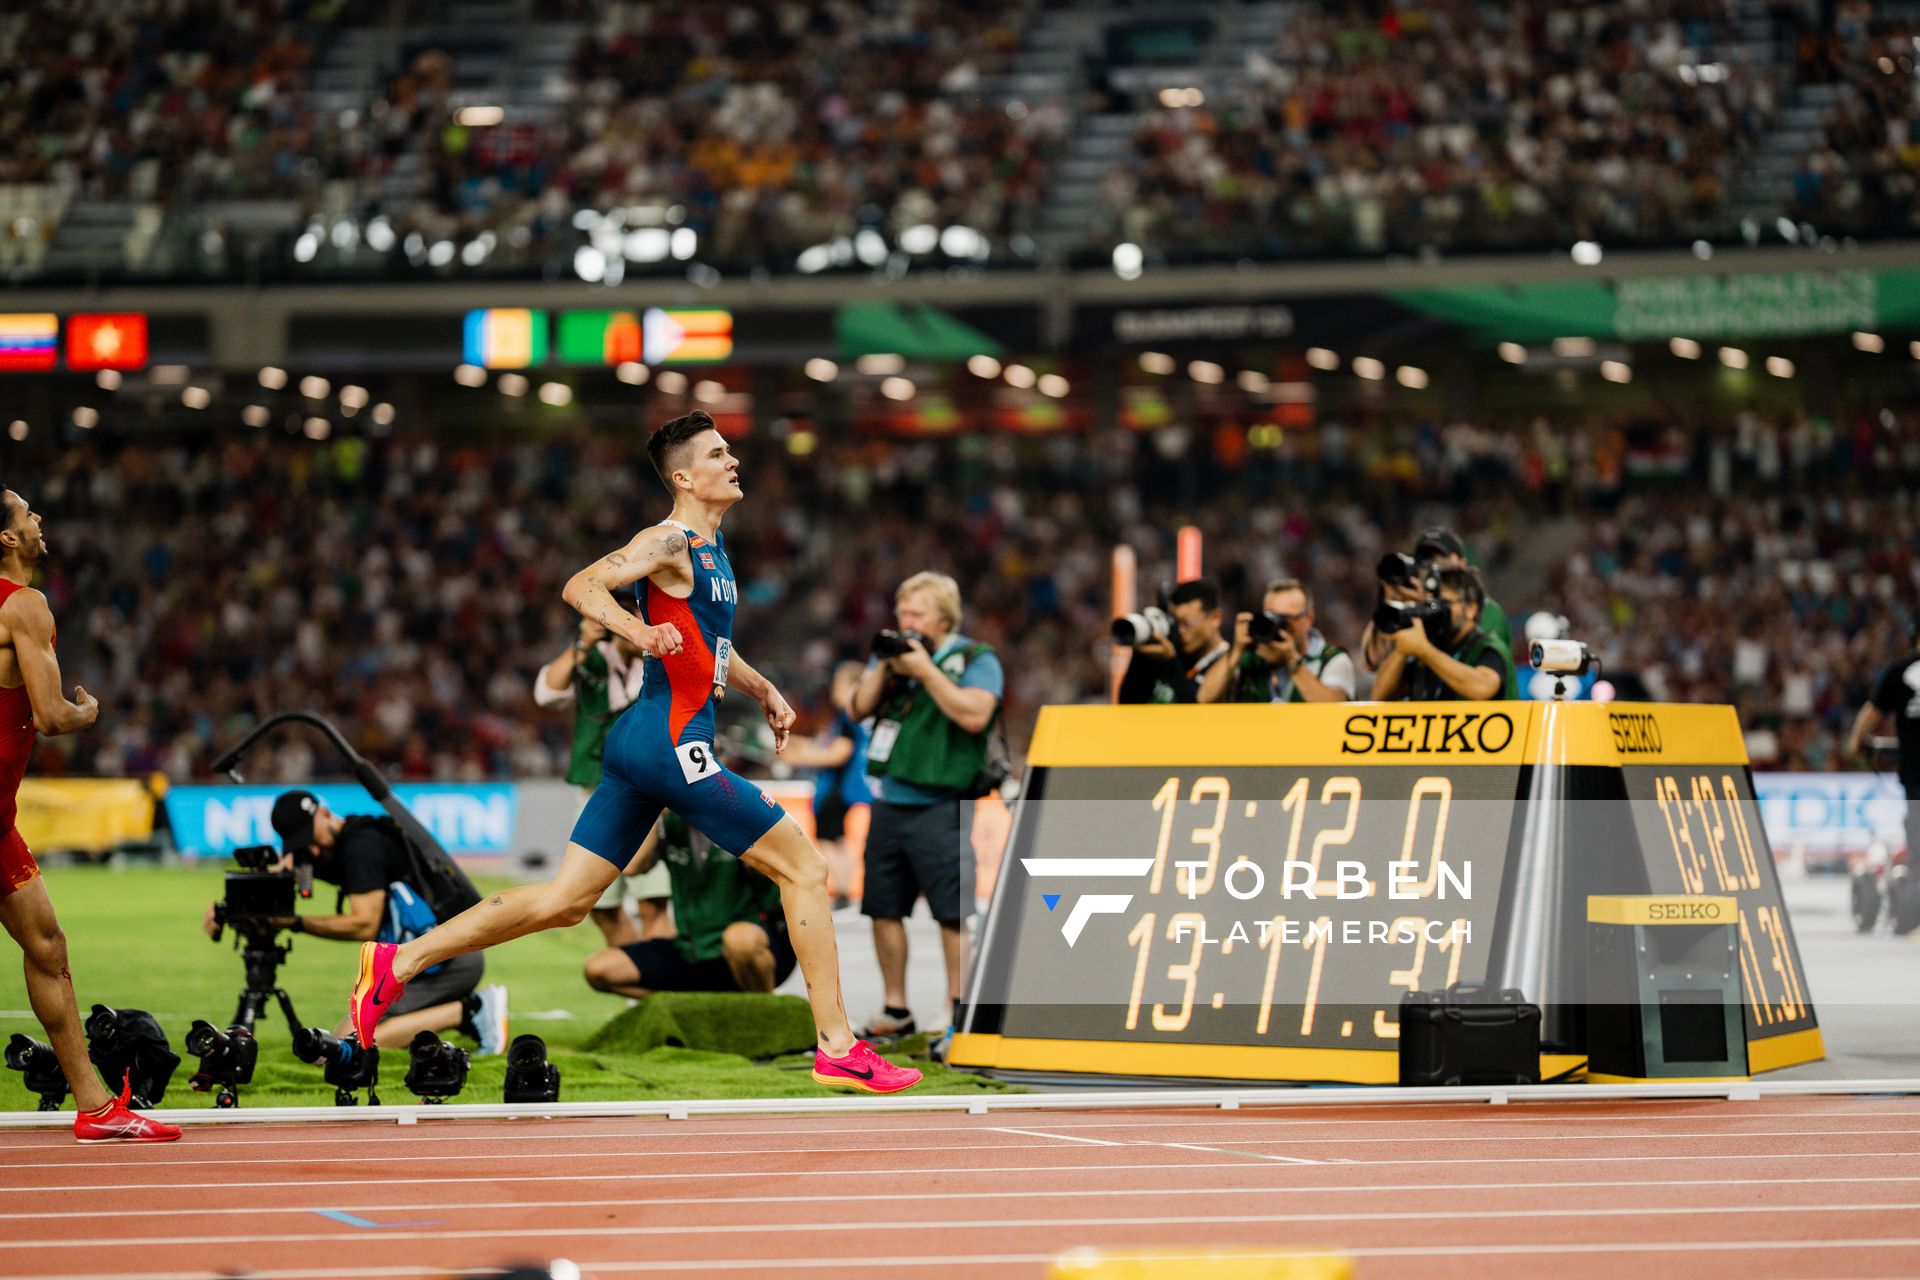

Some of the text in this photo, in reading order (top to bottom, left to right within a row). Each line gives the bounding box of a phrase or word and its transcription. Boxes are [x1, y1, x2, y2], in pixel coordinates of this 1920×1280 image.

[1342, 713, 1514, 755] SEIKO
[1608, 712, 1663, 755] SEIKO
[688, 746, 708, 774] 9
[1757, 788, 1878, 830] TDK
[1655, 775, 1761, 894] 13:12.0
[1648, 903, 1721, 920] SEIKO
